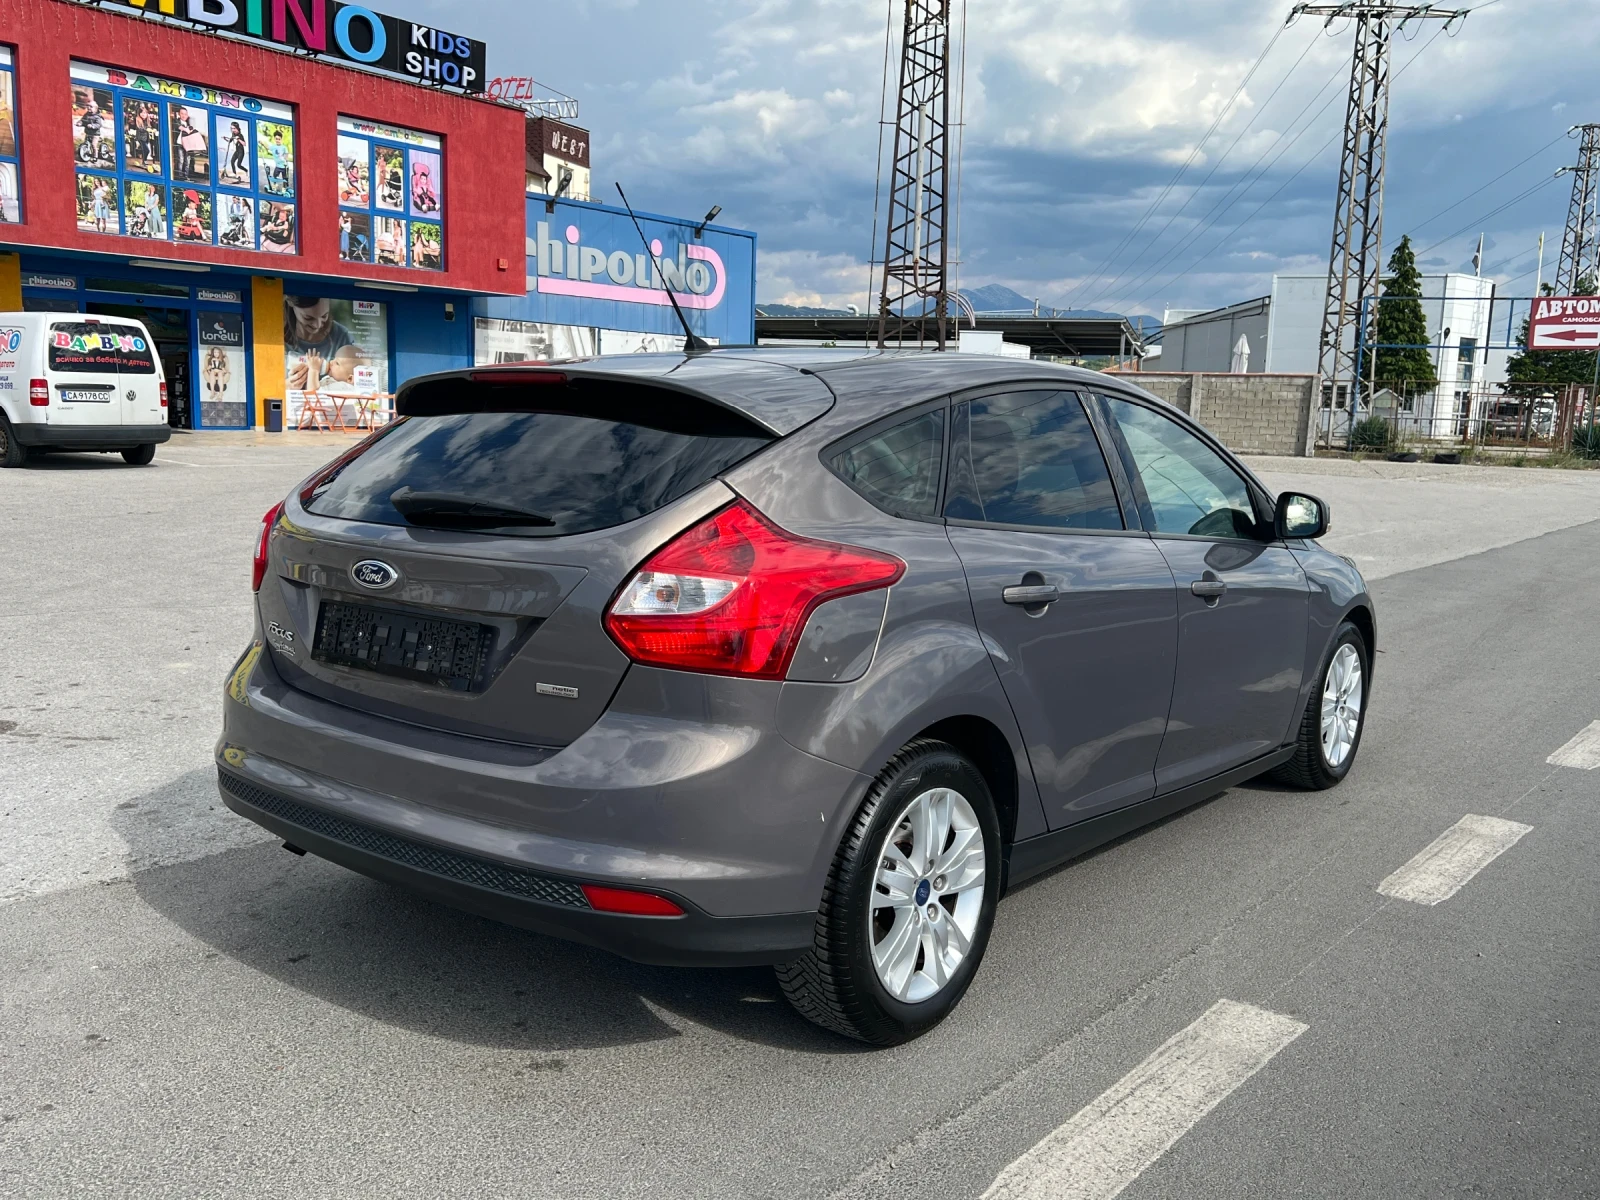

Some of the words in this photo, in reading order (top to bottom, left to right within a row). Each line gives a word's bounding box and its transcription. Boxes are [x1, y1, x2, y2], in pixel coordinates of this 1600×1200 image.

[411, 24, 471, 58] KIDS
[405, 52, 477, 86] SHOP
[106, 69, 263, 112] BAMBINO
[54, 331, 146, 353] BAMBINO
[360, 564, 384, 583] Ford
